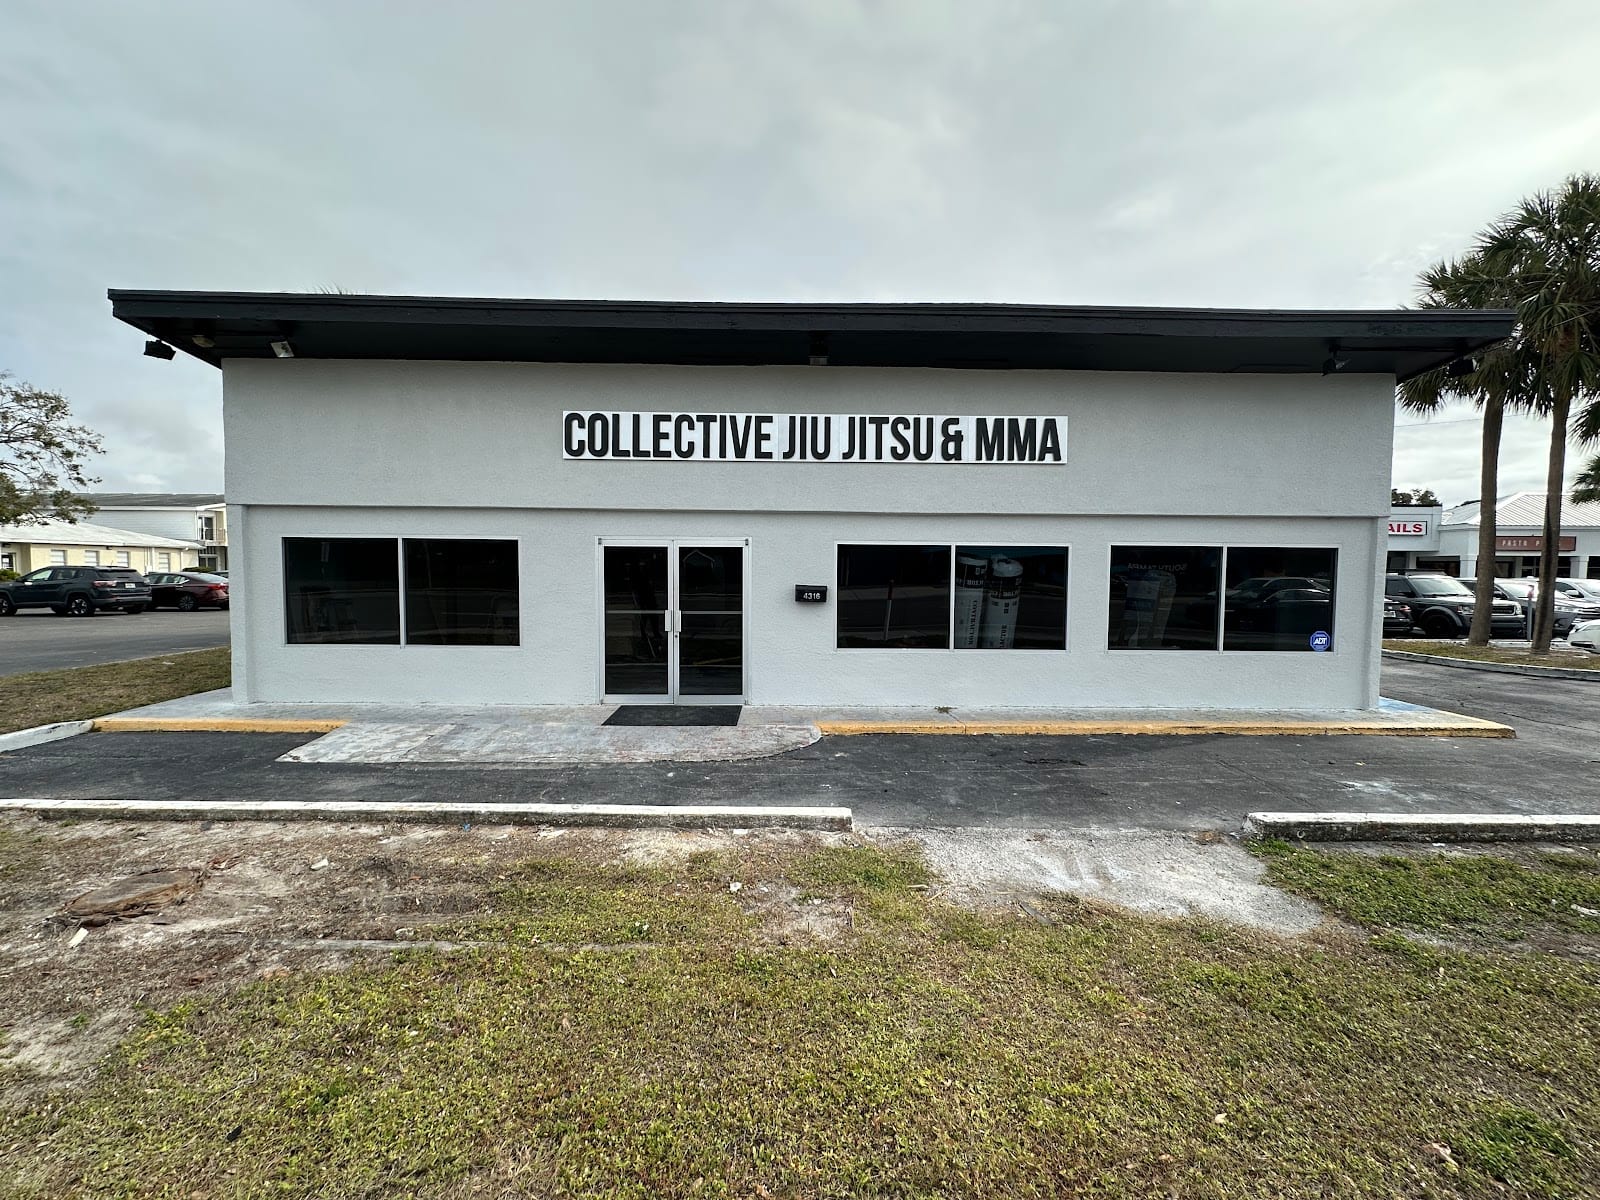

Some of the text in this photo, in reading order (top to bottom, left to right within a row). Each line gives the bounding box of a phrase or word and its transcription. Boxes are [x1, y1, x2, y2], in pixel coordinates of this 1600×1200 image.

[564, 412, 1062, 463] COLLECTIVE JIU JITSU & MMA
[803, 592, 821, 600] 4316
[1313, 637, 1328, 645] ADT
